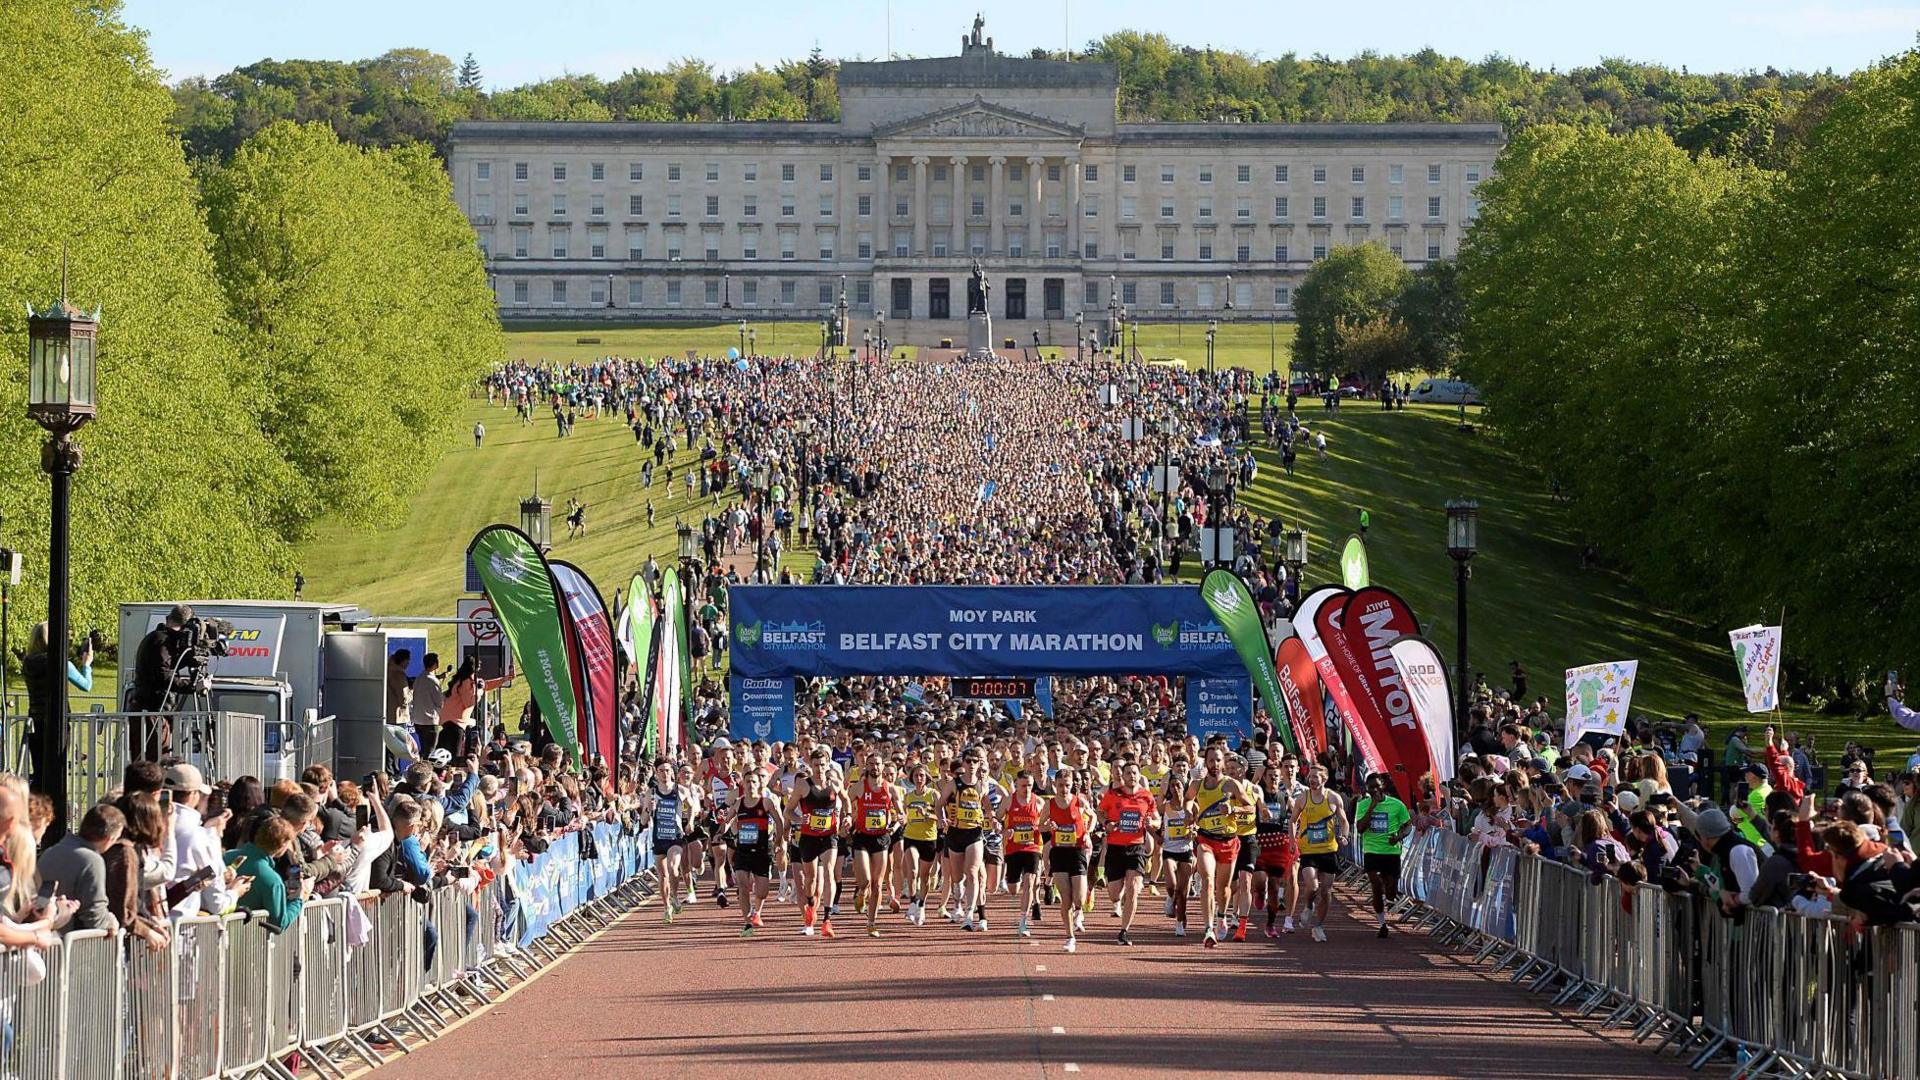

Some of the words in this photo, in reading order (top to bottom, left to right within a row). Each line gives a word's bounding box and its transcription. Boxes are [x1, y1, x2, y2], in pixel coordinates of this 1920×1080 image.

[1365, 600, 1391, 613] DAILY
[949, 609, 987, 623] MOY
[992, 610, 1037, 623] PARK
[762, 632, 826, 643] BELFAST
[839, 633, 942, 650] BELFAST
[948, 633, 1003, 650] CITY
[1010, 633, 1143, 651] MARATHON
[1180, 632, 1232, 643] BELFAS
[1334, 632, 1345, 647] THE
[1341, 644, 1357, 666] HOME
[1352, 664, 1362, 676] OF
[1359, 607, 1417, 730] Mirror
[970, 682, 1026, 695] 0:00:07
[537, 648, 576, 745] #MoyParkMiles
[743, 693, 783, 701] Downtown
[1209, 693, 1239, 701] Translink
[743, 705, 783, 713] Downtown
[1202, 703, 1239, 714] Mirror
[864, 792, 872, 800] H
[816, 818, 826, 826] 20
[1211, 818, 1222, 826] 12
[1019, 833, 1029, 841] 19
[1175, 828, 1181, 836] 2
[1060, 834, 1070, 842] 22
